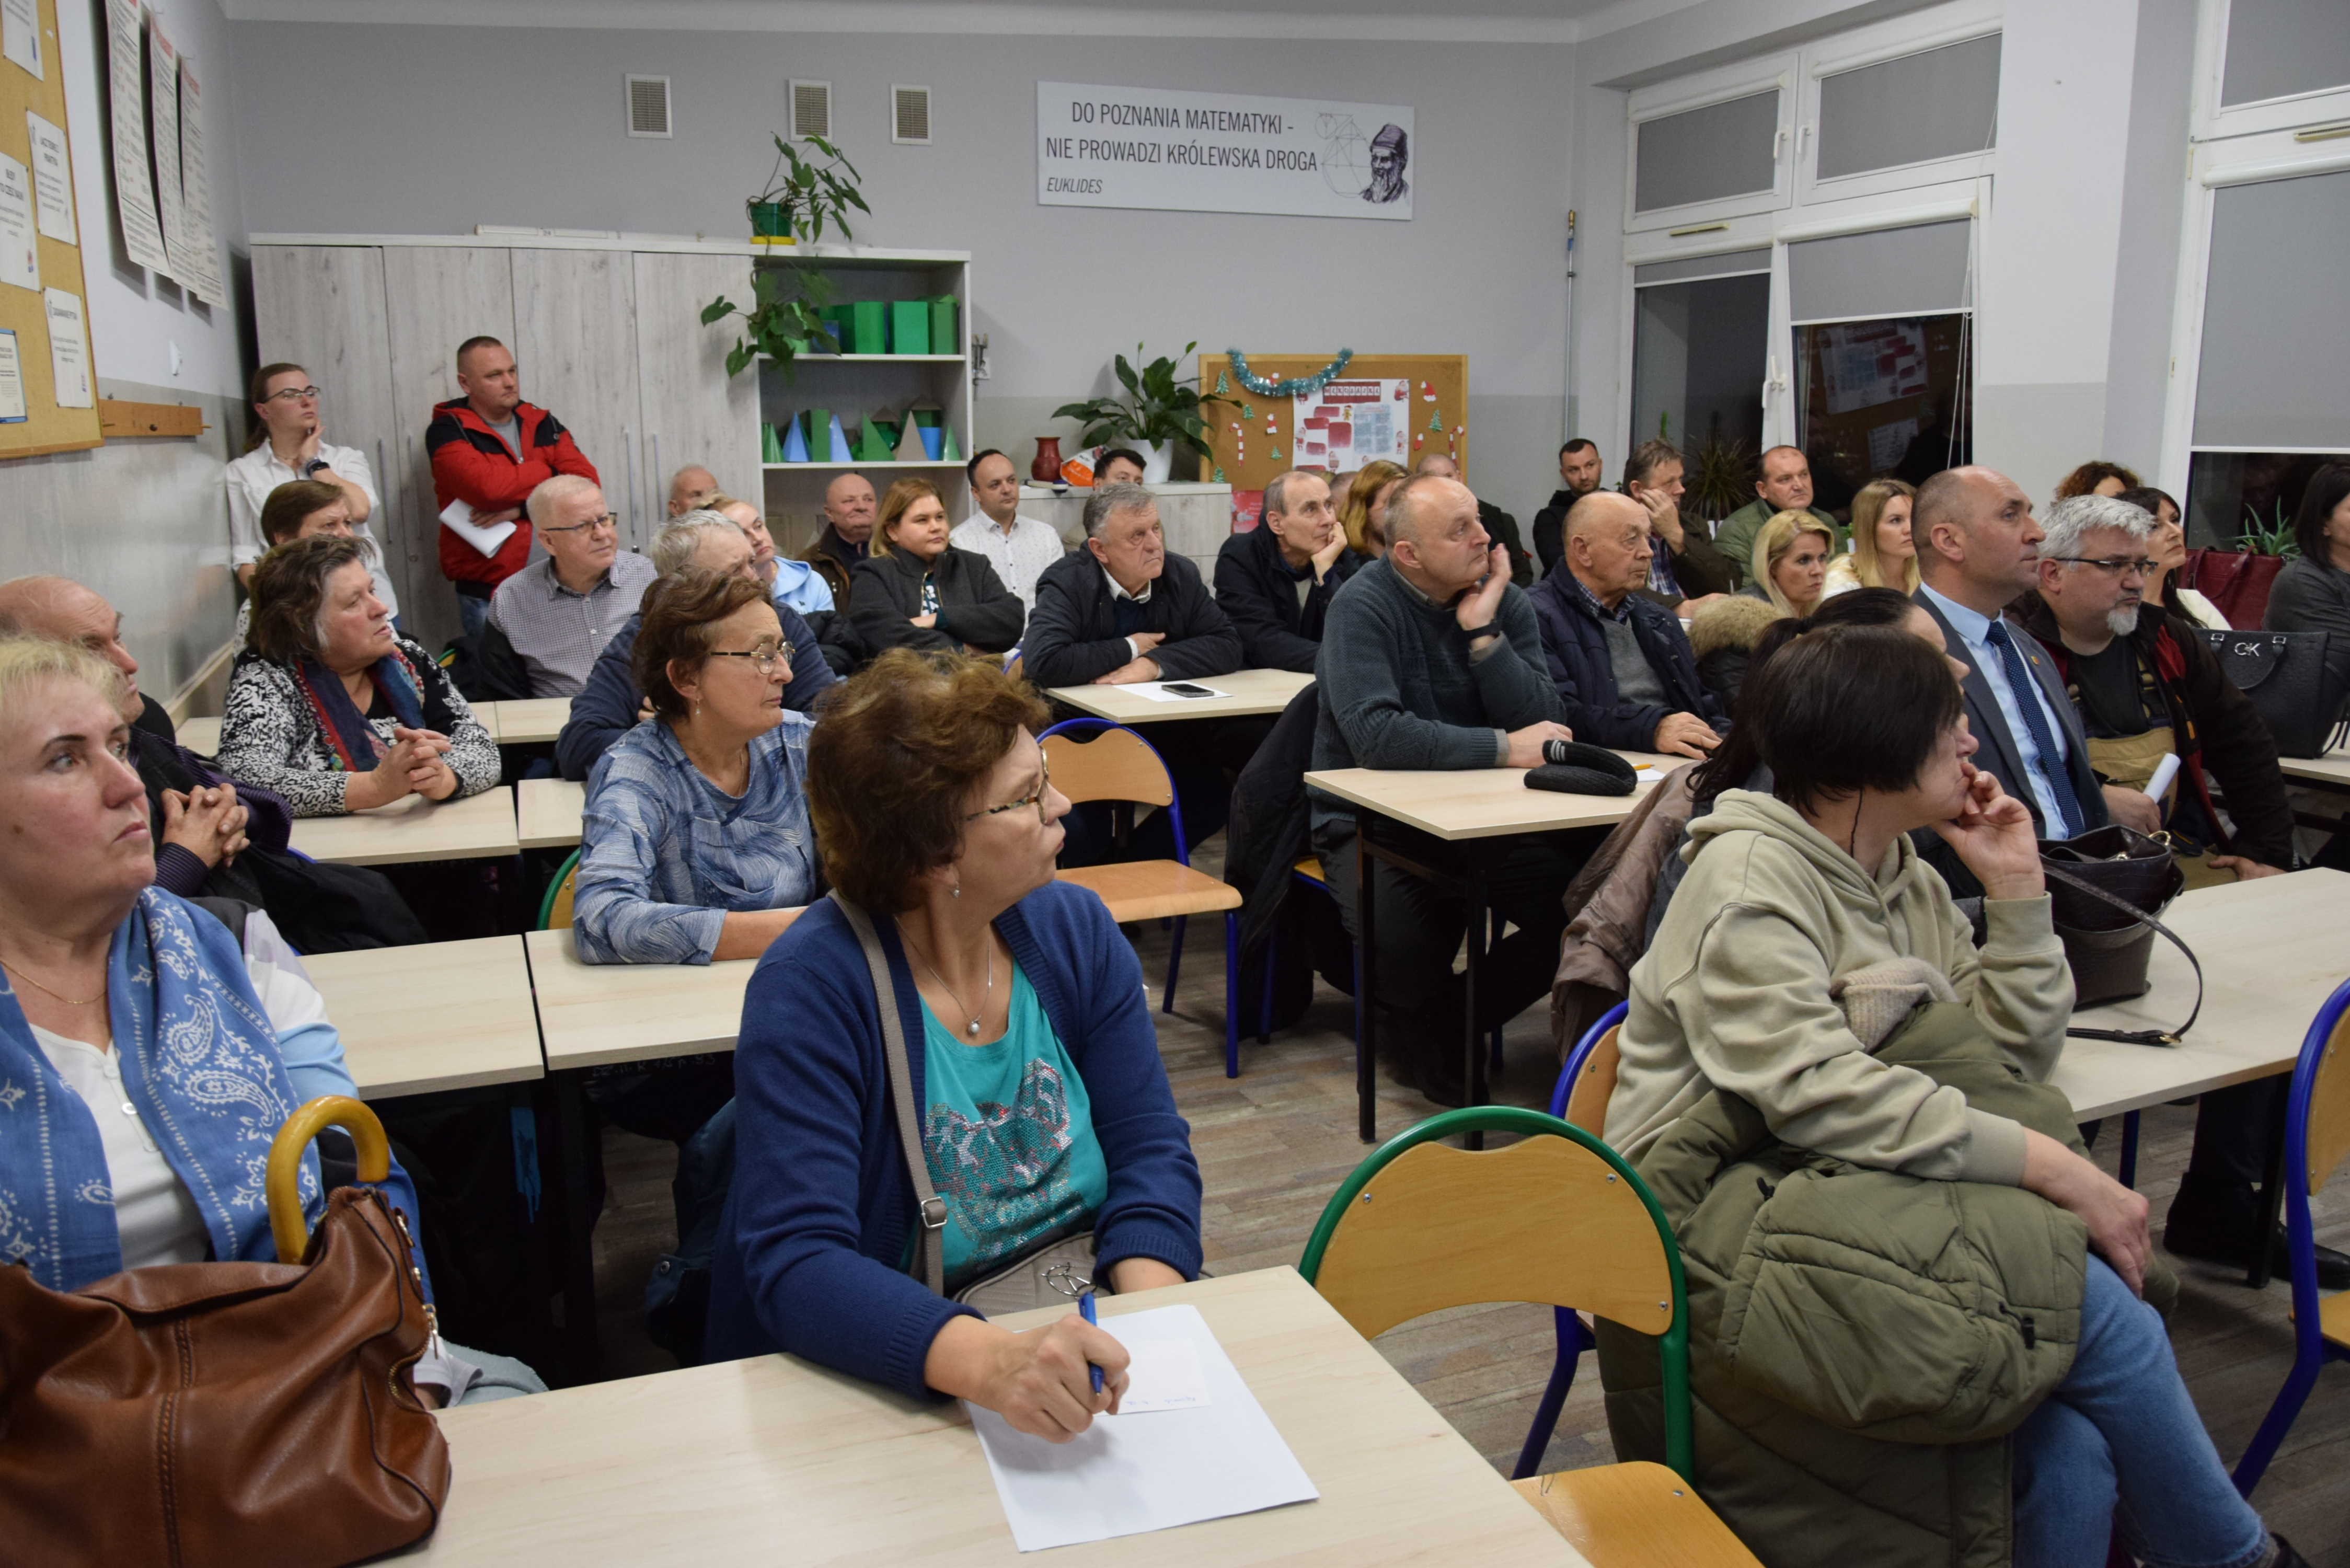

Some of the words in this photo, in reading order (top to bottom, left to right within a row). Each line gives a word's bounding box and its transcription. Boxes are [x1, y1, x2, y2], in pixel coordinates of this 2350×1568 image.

[1072, 102, 1094, 123] DO
[1101, 104, 1180, 128] POZNANIA
[1186, 109, 1281, 134] MATEMATYKI
[1046, 137, 1073, 158] NIE
[1079, 139, 1160, 163] PROWADZI
[1168, 139, 1260, 168] KRÓLEWSKA
[1266, 149, 1317, 171] DROGA
[1047, 177, 1102, 193] EUKLIDES
[2234, 642, 2261, 656] CK
